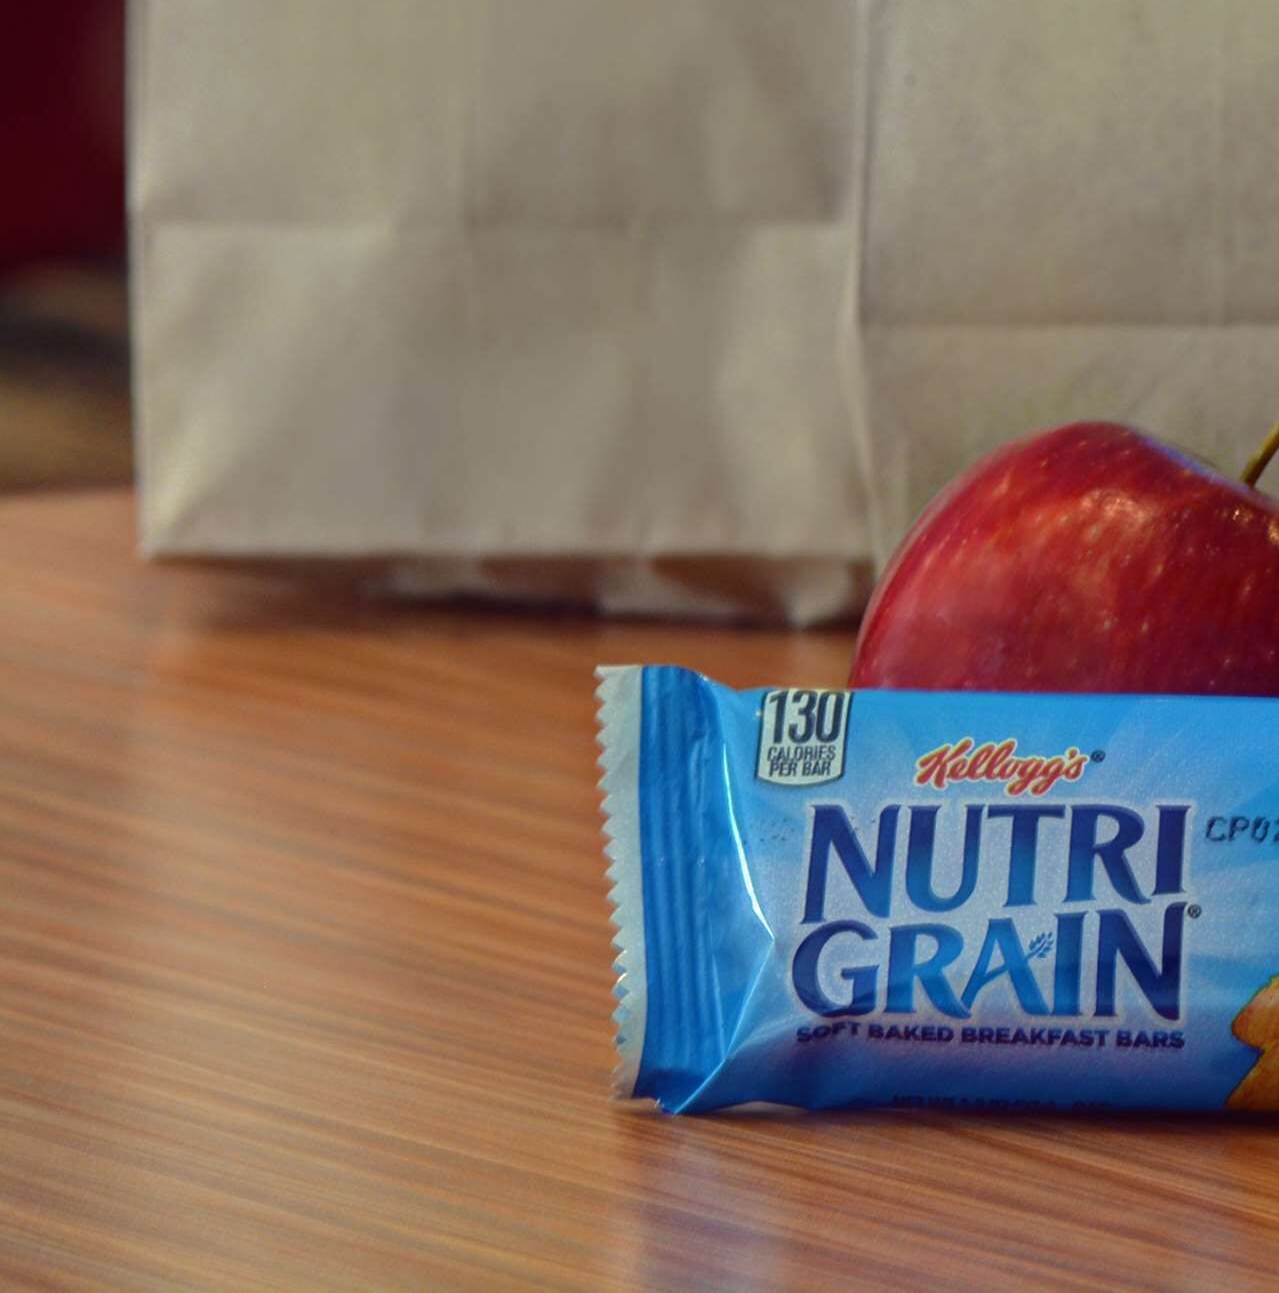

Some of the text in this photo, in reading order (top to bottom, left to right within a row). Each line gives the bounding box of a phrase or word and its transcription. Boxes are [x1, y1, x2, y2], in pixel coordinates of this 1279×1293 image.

[769, 690, 845, 744] 130
[767, 745, 836, 763] CALORIES
[768, 760, 833, 777] PER BAR
[916, 738, 1090, 796] Kellogg's
[801, 804, 1193, 925] NUTRI
[791, 901, 1189, 1022] GRAIN
[796, 1022, 1185, 1050] SOFT BAKED BREAKFAST BARS
